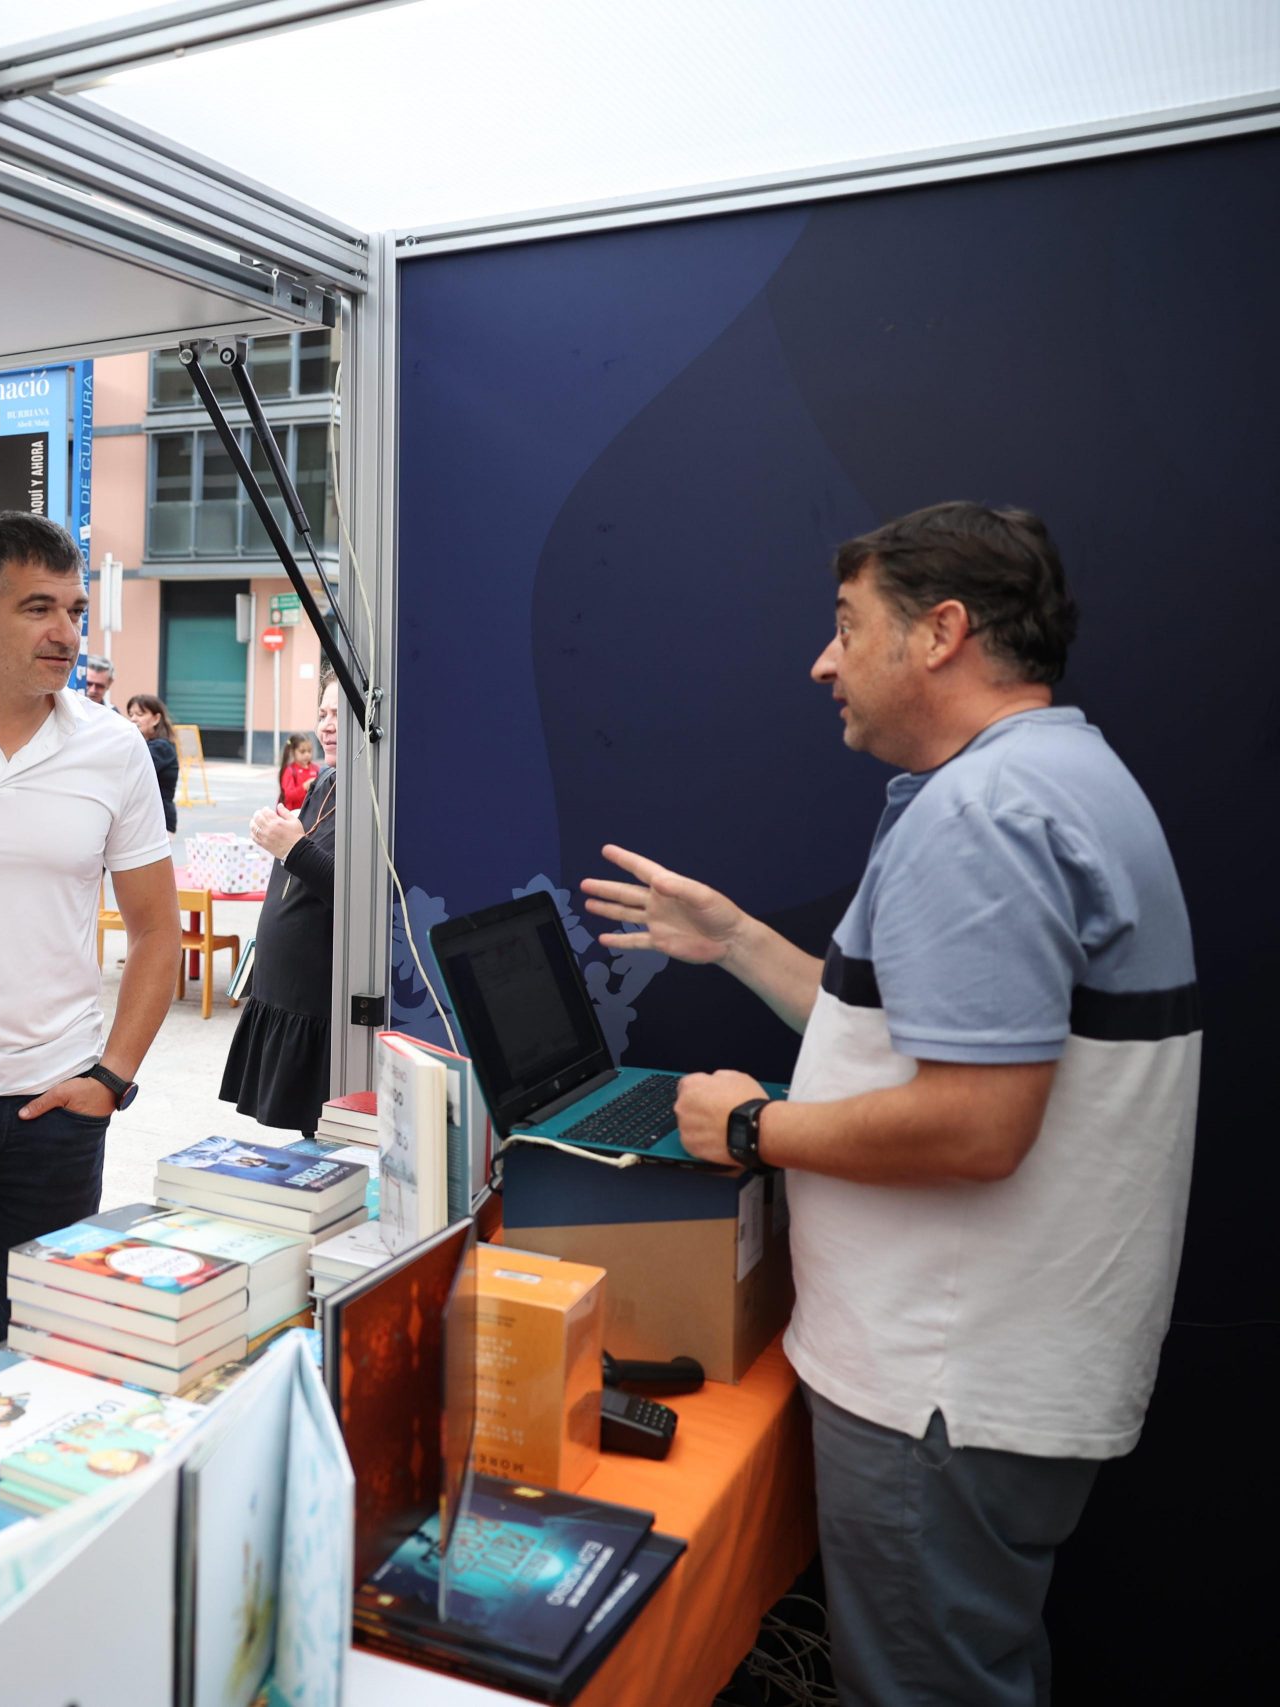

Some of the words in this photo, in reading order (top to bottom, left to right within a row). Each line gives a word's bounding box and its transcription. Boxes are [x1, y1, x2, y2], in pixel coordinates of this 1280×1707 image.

[7, 408, 49, 419] BURRIANA
[81, 375, 93, 471] CULTURA
[31, 440, 43, 476] AHORA
[31, 479, 43, 487] Y
[80, 478, 91, 505] DE
[27, 489, 44, 515] AQUÍ
